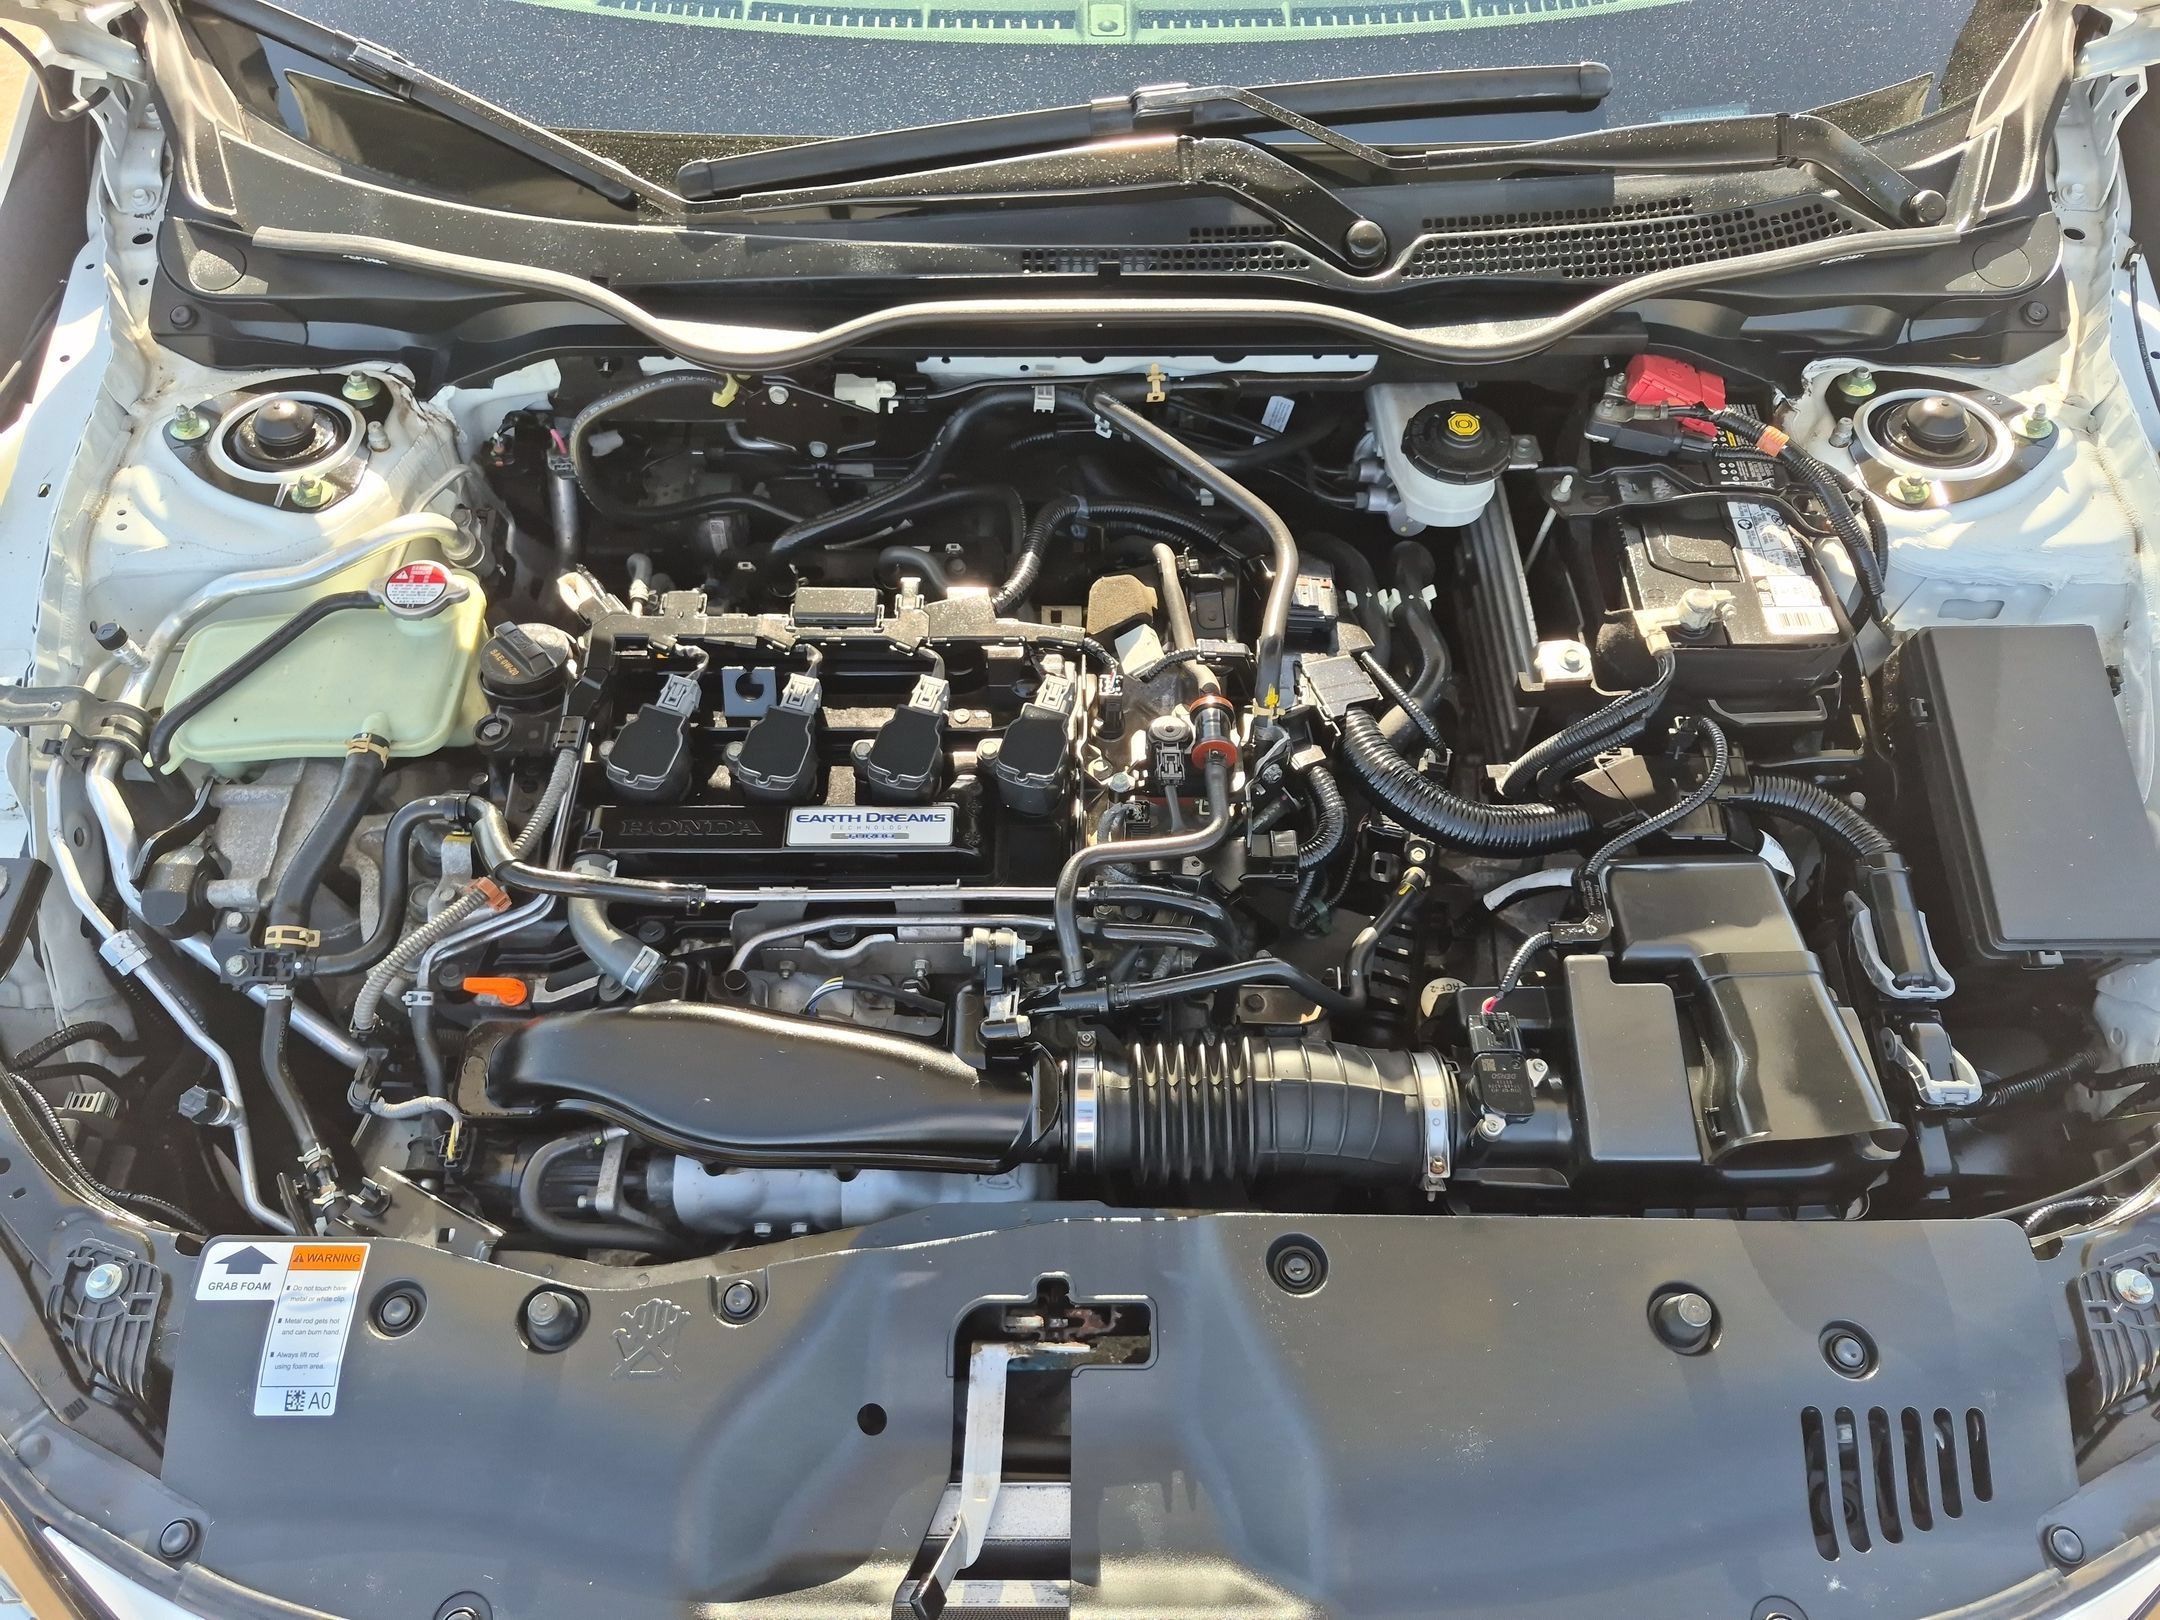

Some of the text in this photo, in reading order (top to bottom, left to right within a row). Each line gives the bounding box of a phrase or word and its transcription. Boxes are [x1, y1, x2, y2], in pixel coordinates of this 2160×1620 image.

[490, 649, 520, 676] SAE 0W-20
[796, 813, 946, 823] EARTH DREAMS
[619, 820, 763, 836] HONDA
[306, 1253, 361, 1263] WARNING
[208, 1282, 271, 1291] GRAB FOAM
[308, 1391, 332, 1410] A0
